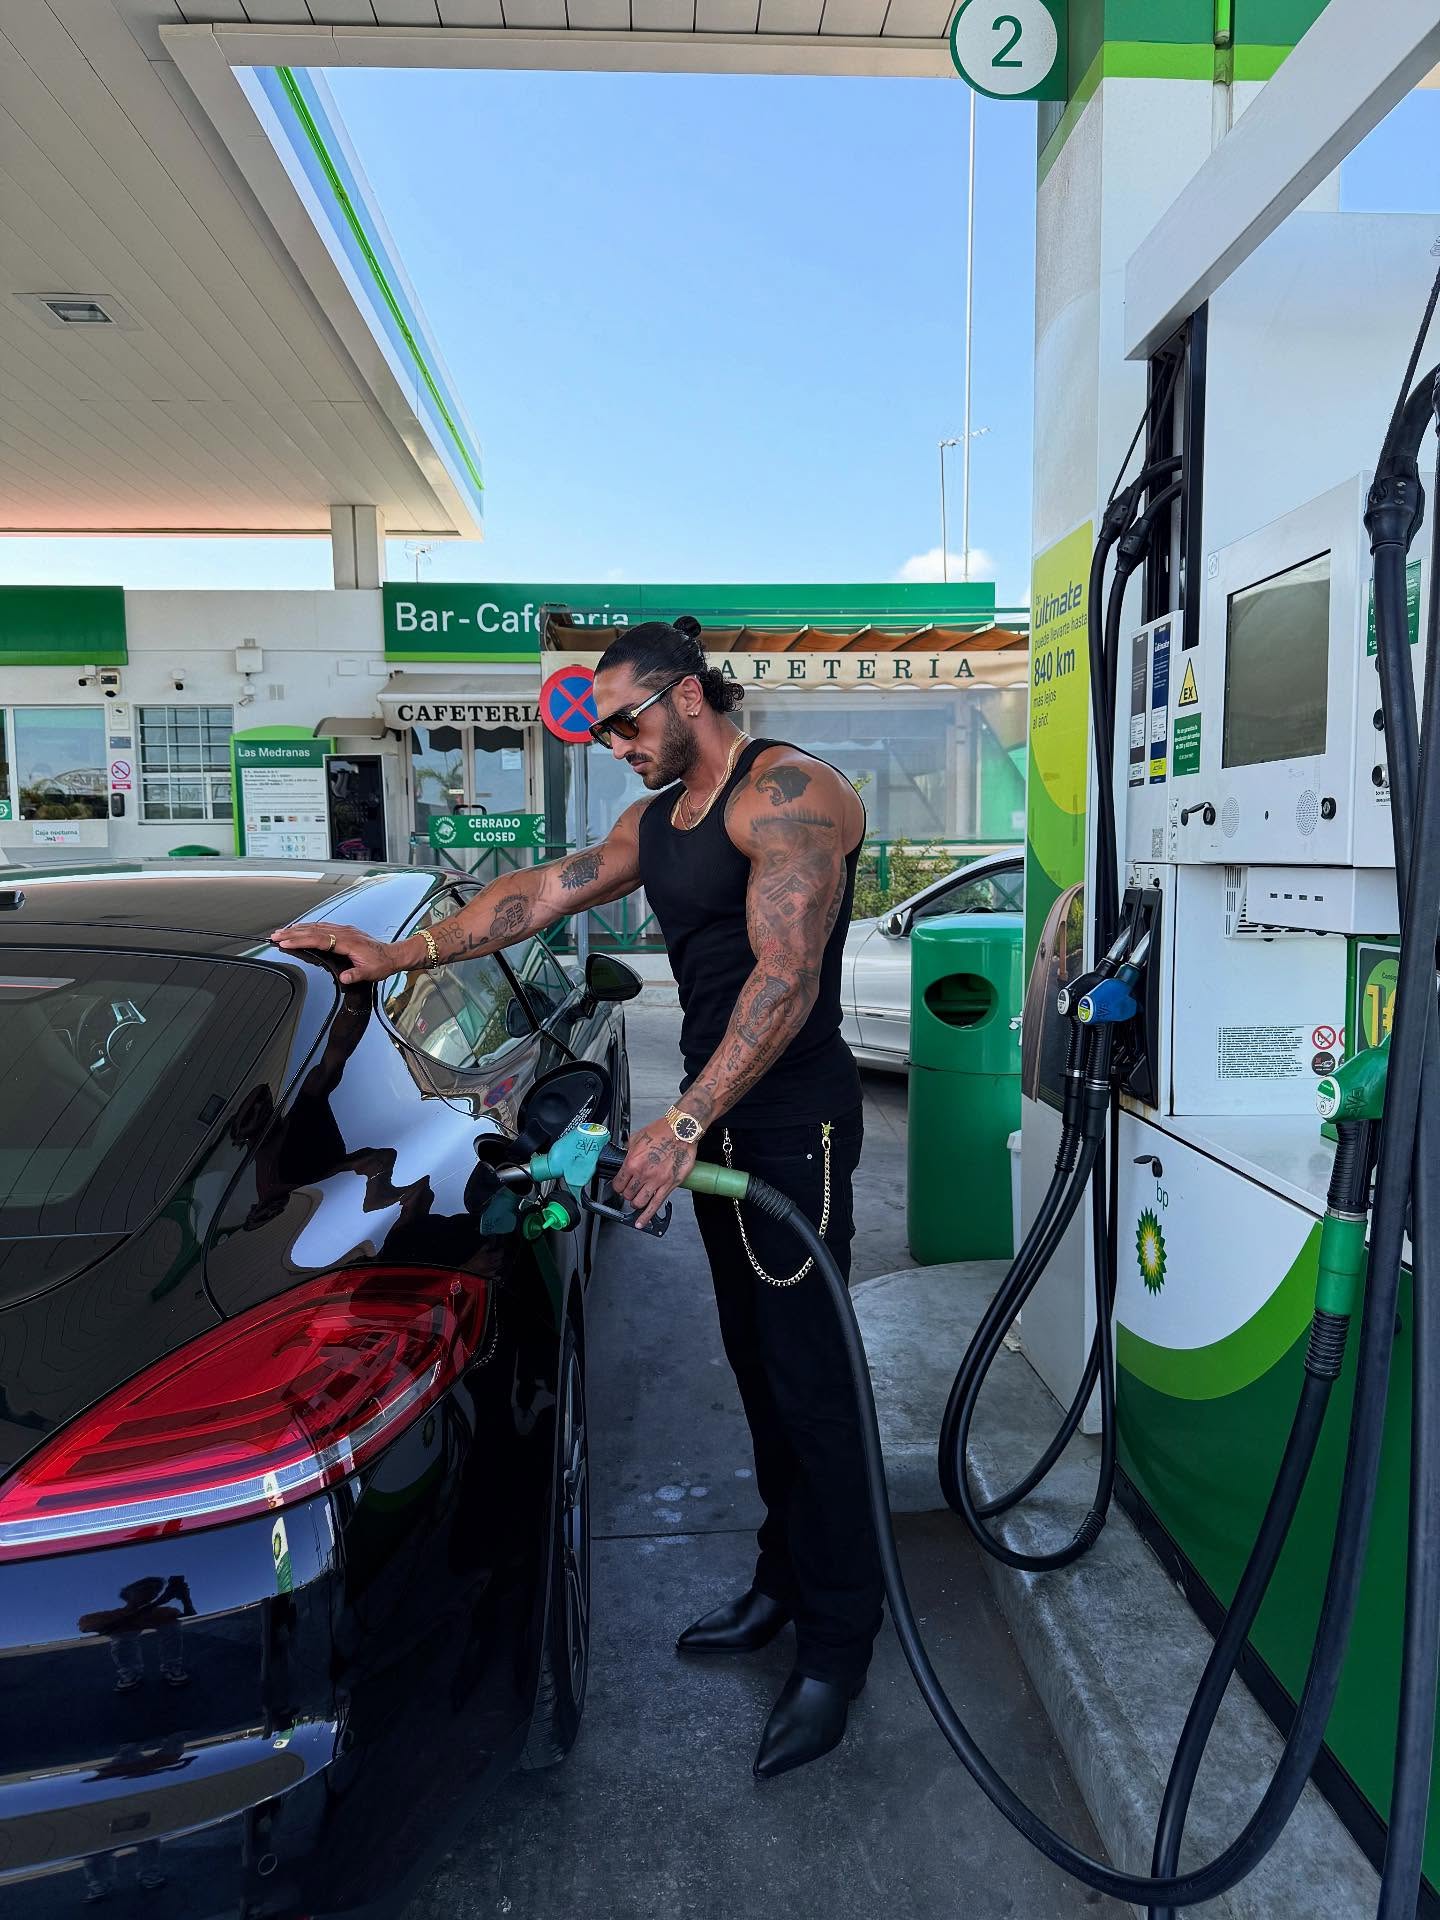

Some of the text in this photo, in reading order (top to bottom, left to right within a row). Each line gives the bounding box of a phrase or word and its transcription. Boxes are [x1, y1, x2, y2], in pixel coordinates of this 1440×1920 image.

[992, 15, 1023, 67] 2
[1035, 581, 1082, 630] ultimate
[722, 659, 975, 680] AFETERIA
[1034, 647, 1075, 687] 840 km
[1183, 685, 1194, 701] EX
[238, 748, 311, 758] Las Medranas
[468, 818, 520, 828] CERRADO
[473, 832, 516, 842] CLOSED
[514, 902, 525, 924] STAY
[1156, 1180, 1169, 1211] bp
